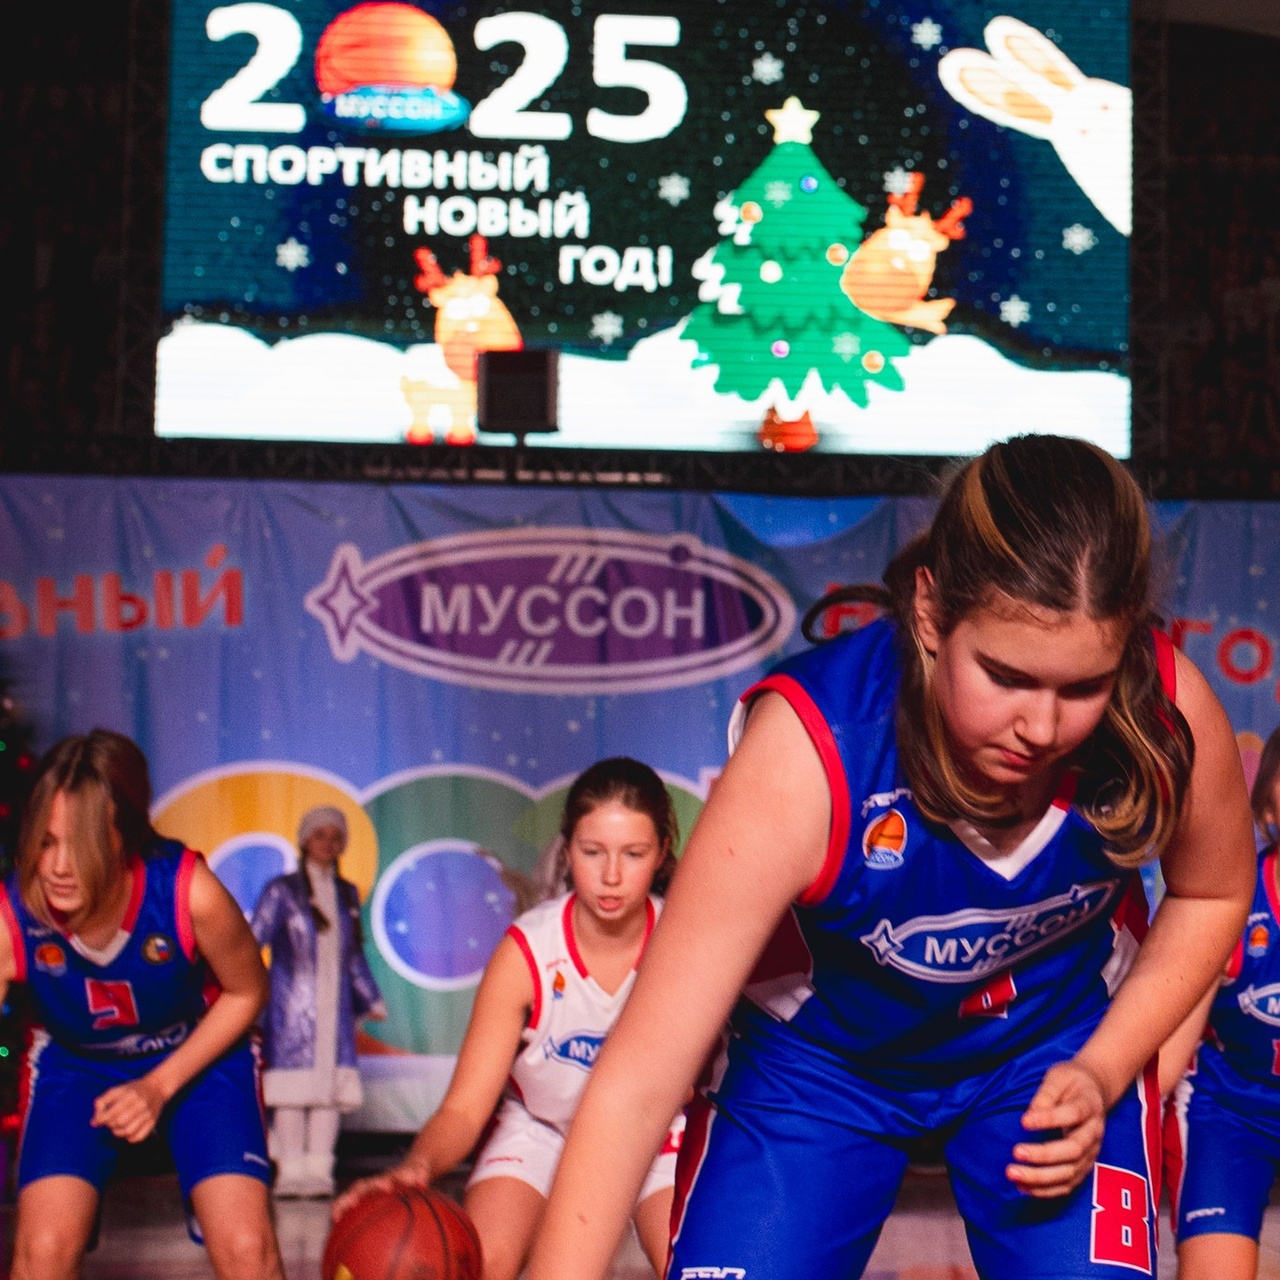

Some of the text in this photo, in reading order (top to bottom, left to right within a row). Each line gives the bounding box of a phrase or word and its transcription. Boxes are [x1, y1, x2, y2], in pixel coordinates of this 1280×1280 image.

[335, 94, 442, 120] МУССОН
[200, 143, 550, 192] СПОРТИВНЫЙ
[403, 191, 590, 238] НОВЫЙ
[419, 583, 706, 639] МУССОН
[924, 899, 1091, 966] МУССОН
[1089, 1161, 1153, 1277] 8
